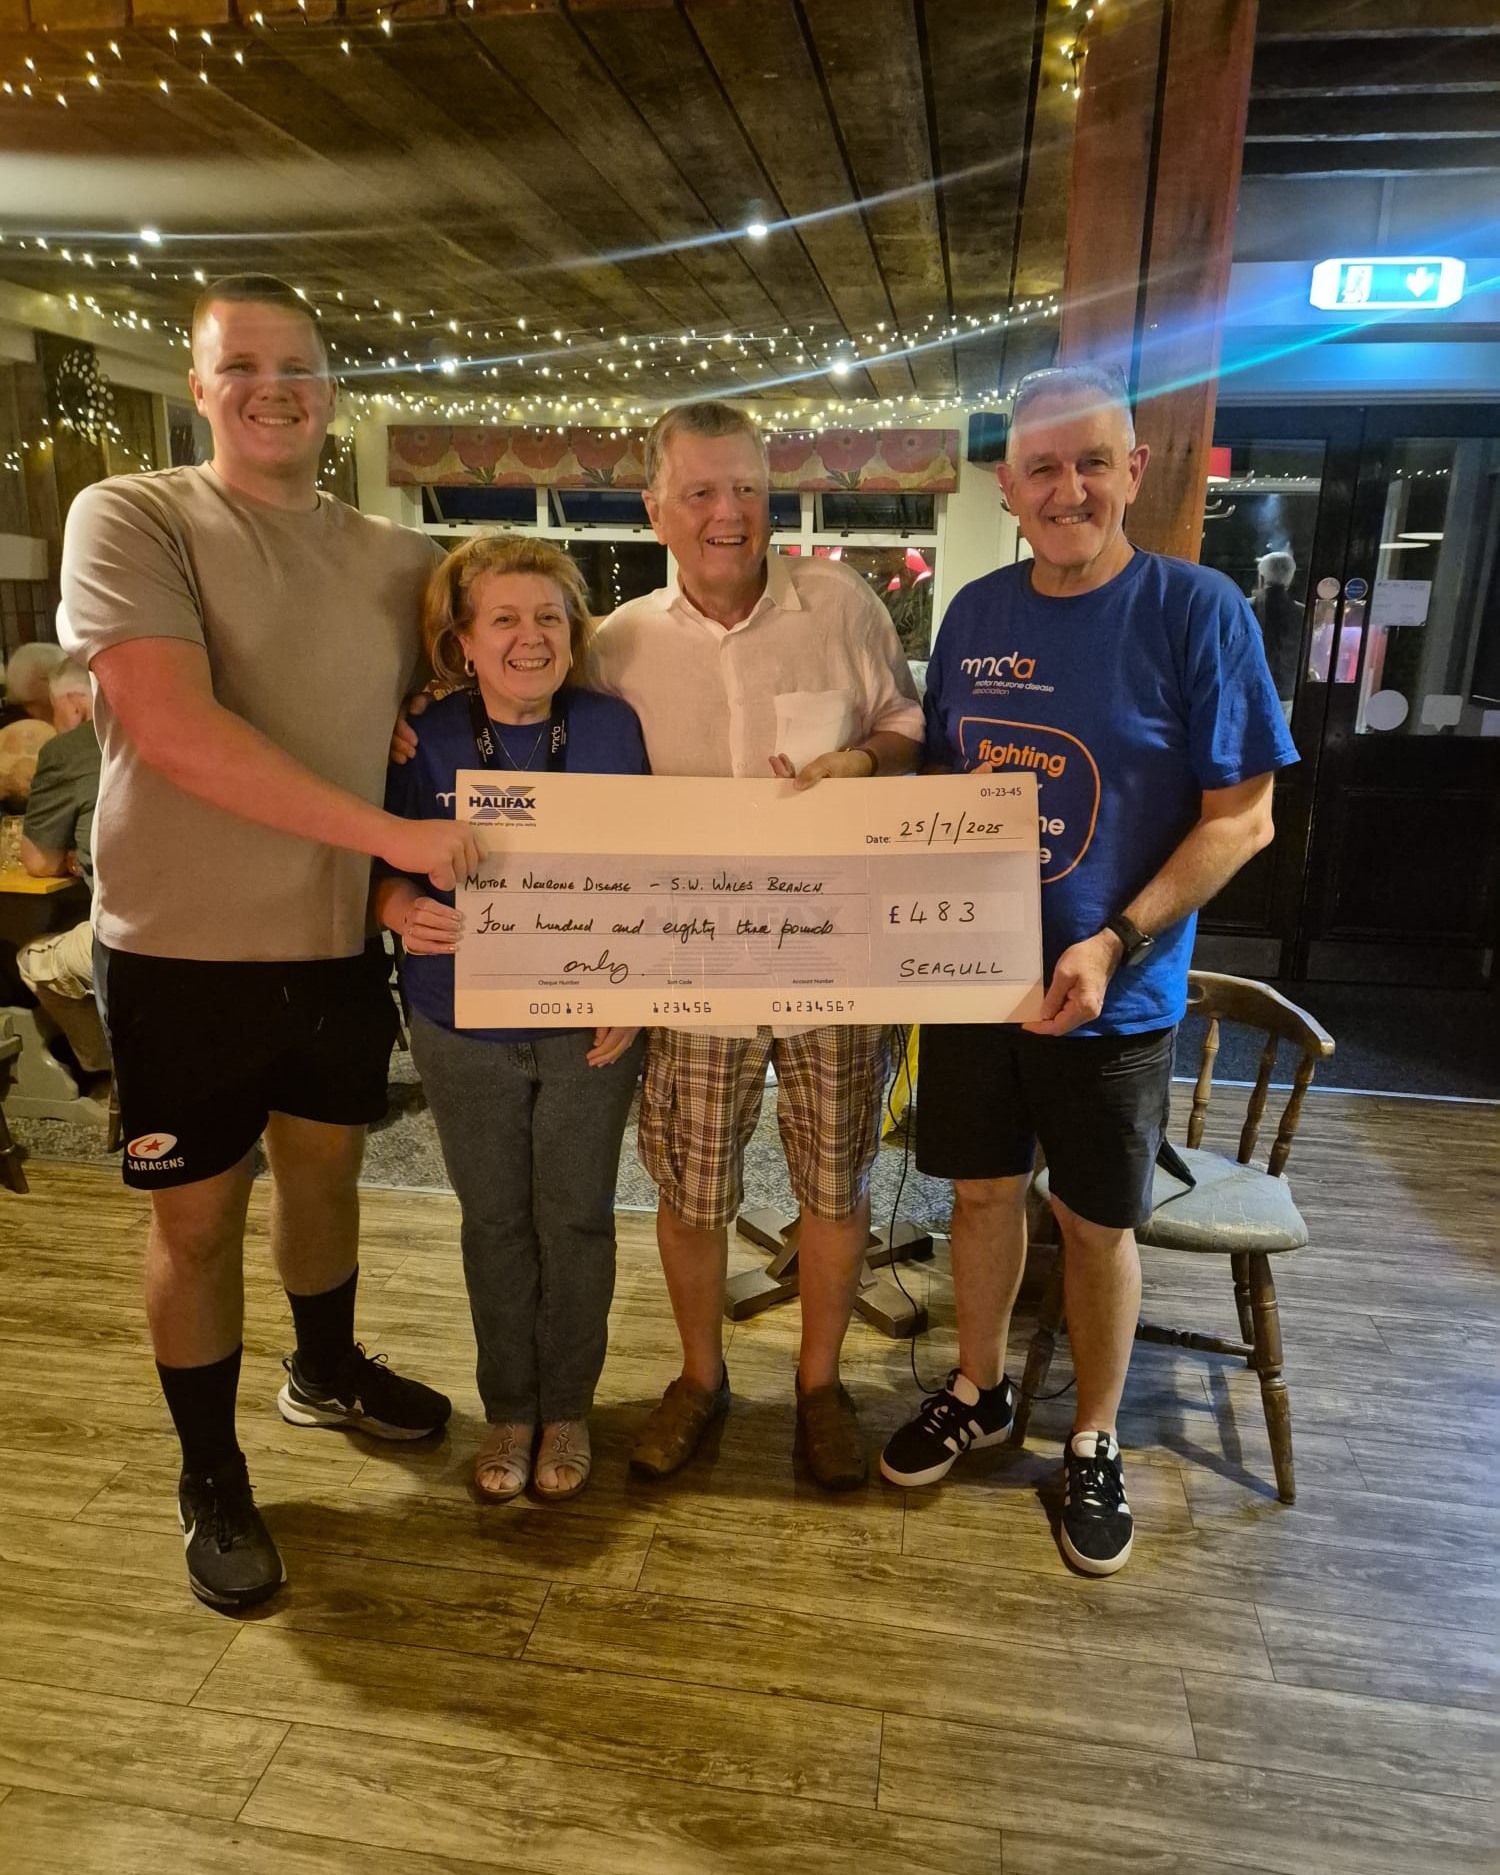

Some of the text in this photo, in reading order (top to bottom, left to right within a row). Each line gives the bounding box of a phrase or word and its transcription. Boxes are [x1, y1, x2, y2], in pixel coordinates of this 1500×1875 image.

[960, 651, 1036, 679] mnda
[994, 681, 1024, 689] neurone
[1025, 683, 1055, 692] disease
[979, 739, 1066, 777] fighting
[980, 787, 1022, 797] 01-23-45
[469, 796, 536, 809] HALIFAX
[866, 811, 1004, 846] Date: 25/7/2025
[536, 914, 593, 932] hundred
[612, 919, 644, 934] and
[663, 918, 715, 943] eighty
[778, 918, 833, 949] pounds
[899, 958, 1003, 977] SEAGULL
[530, 1003, 593, 1014] 000123
[653, 1001, 712, 1013] 123456
[773, 1000, 854, 1012] 01234567
